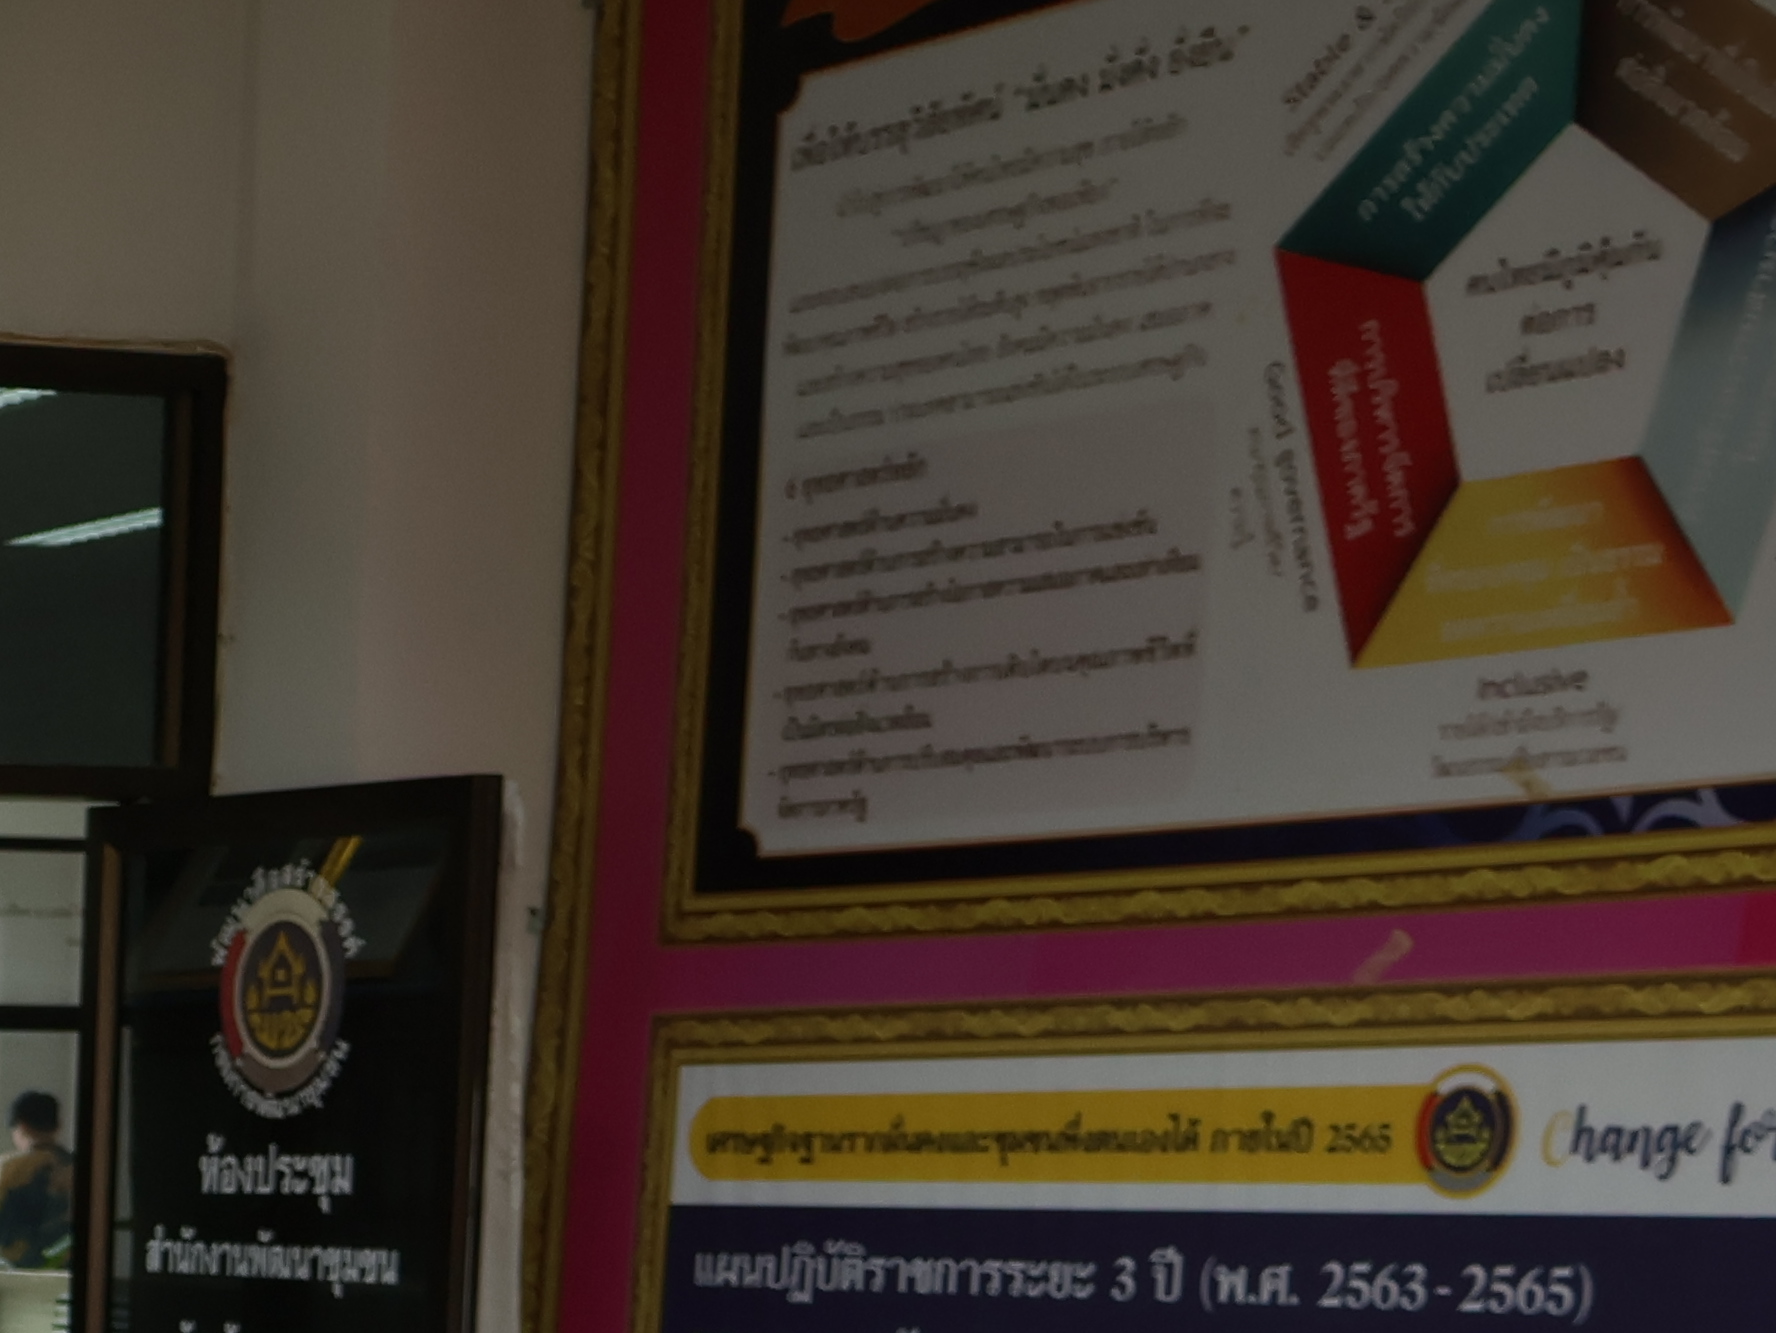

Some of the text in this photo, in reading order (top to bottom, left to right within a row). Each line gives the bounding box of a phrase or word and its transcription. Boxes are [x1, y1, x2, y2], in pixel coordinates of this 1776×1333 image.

[197, 1131, 355, 1215] ห้องประชุม
[1324, 1122, 1393, 1154] 2565
[1719, 1100, 1776, 1186] fo
[145, 1222, 401, 1299] สำนักงานพัฒนาชุมชน
[693, 1238, 1096, 1304] แผนปฏิบัติราชการระยะ
[1110, 1256, 1137, 1303] 3
[1149, 1245, 1185, 1304] ปี
[1199, 1255, 1301, 1314] (พ.ศ.
